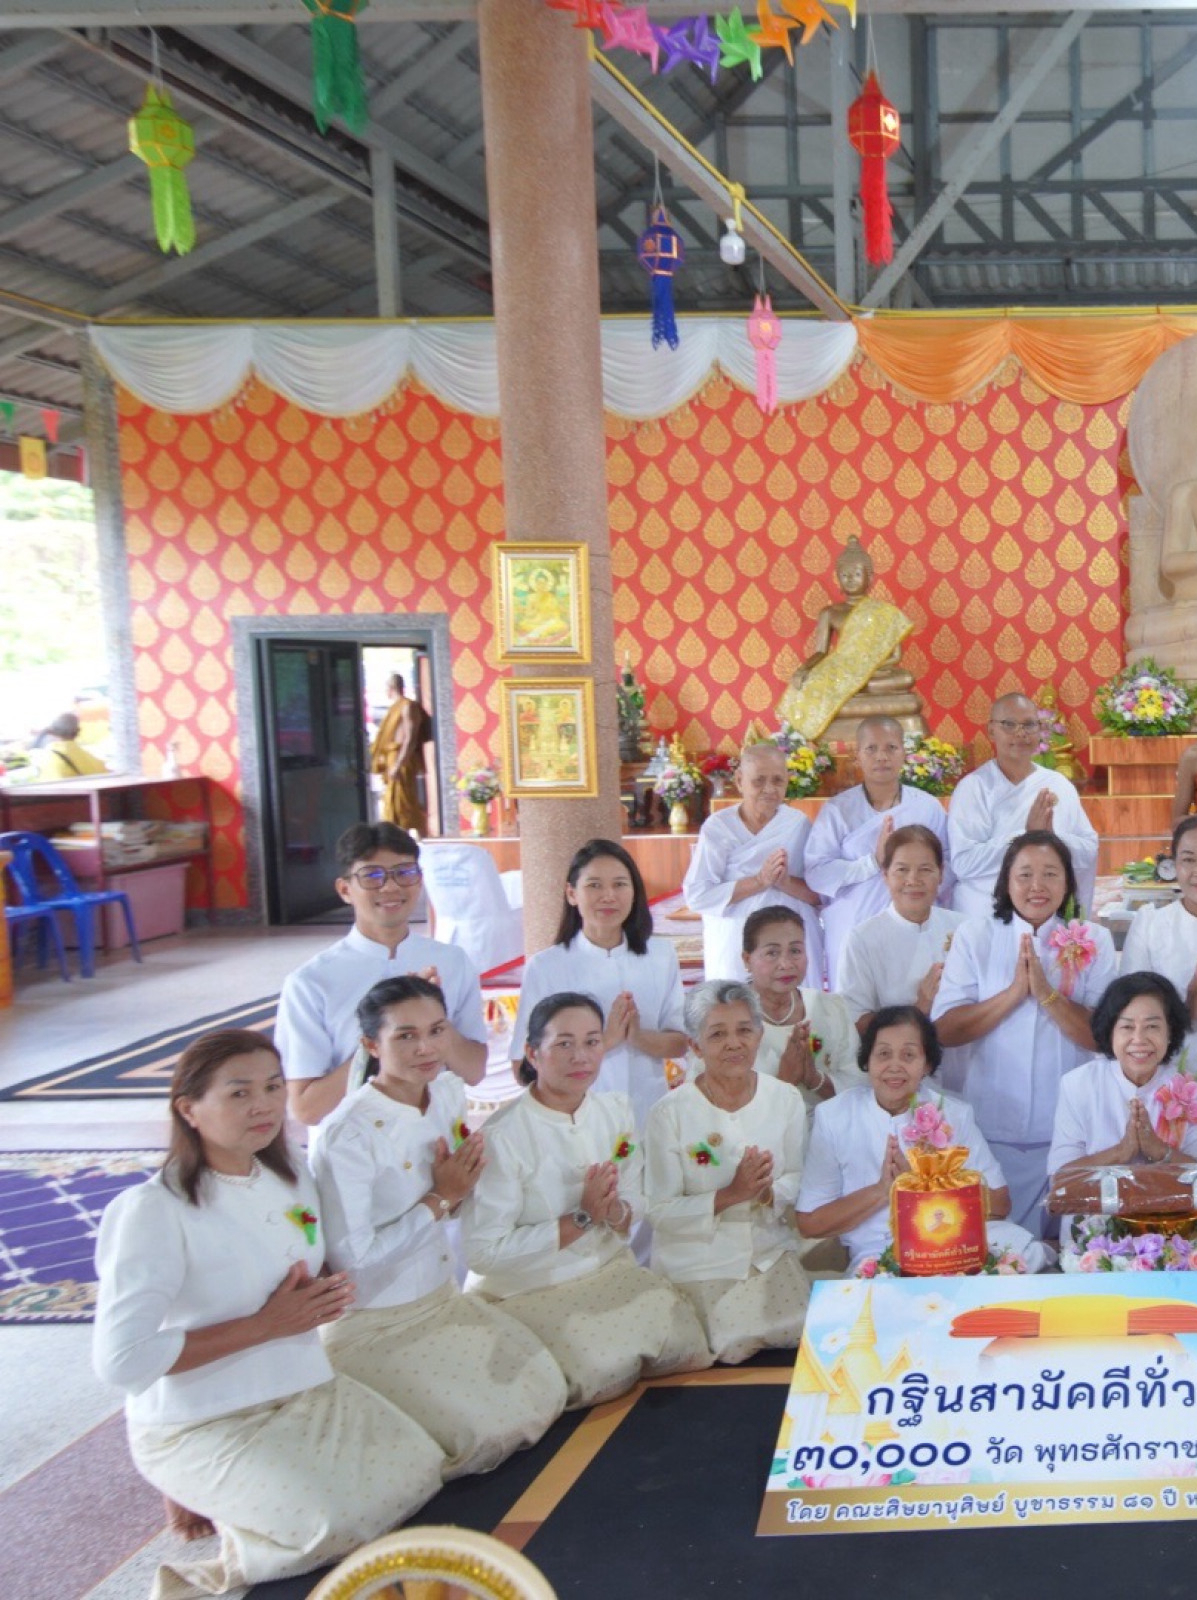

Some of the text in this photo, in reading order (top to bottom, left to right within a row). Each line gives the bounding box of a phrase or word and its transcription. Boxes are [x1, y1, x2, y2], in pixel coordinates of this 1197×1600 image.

[793, 1442, 972, 1475] ๓๐,๐๐๐
[986, 1437, 1023, 1464] วัด
[789, 1501, 827, 1520] โดย
[836, 1494, 1005, 1520] คณะศิษยานุศิษย์
[1014, 1496, 1114, 1518] บูชาธรรม
[1123, 1495, 1154, 1509] ๘๑
[1162, 1488, 1177, 1506] ปี
